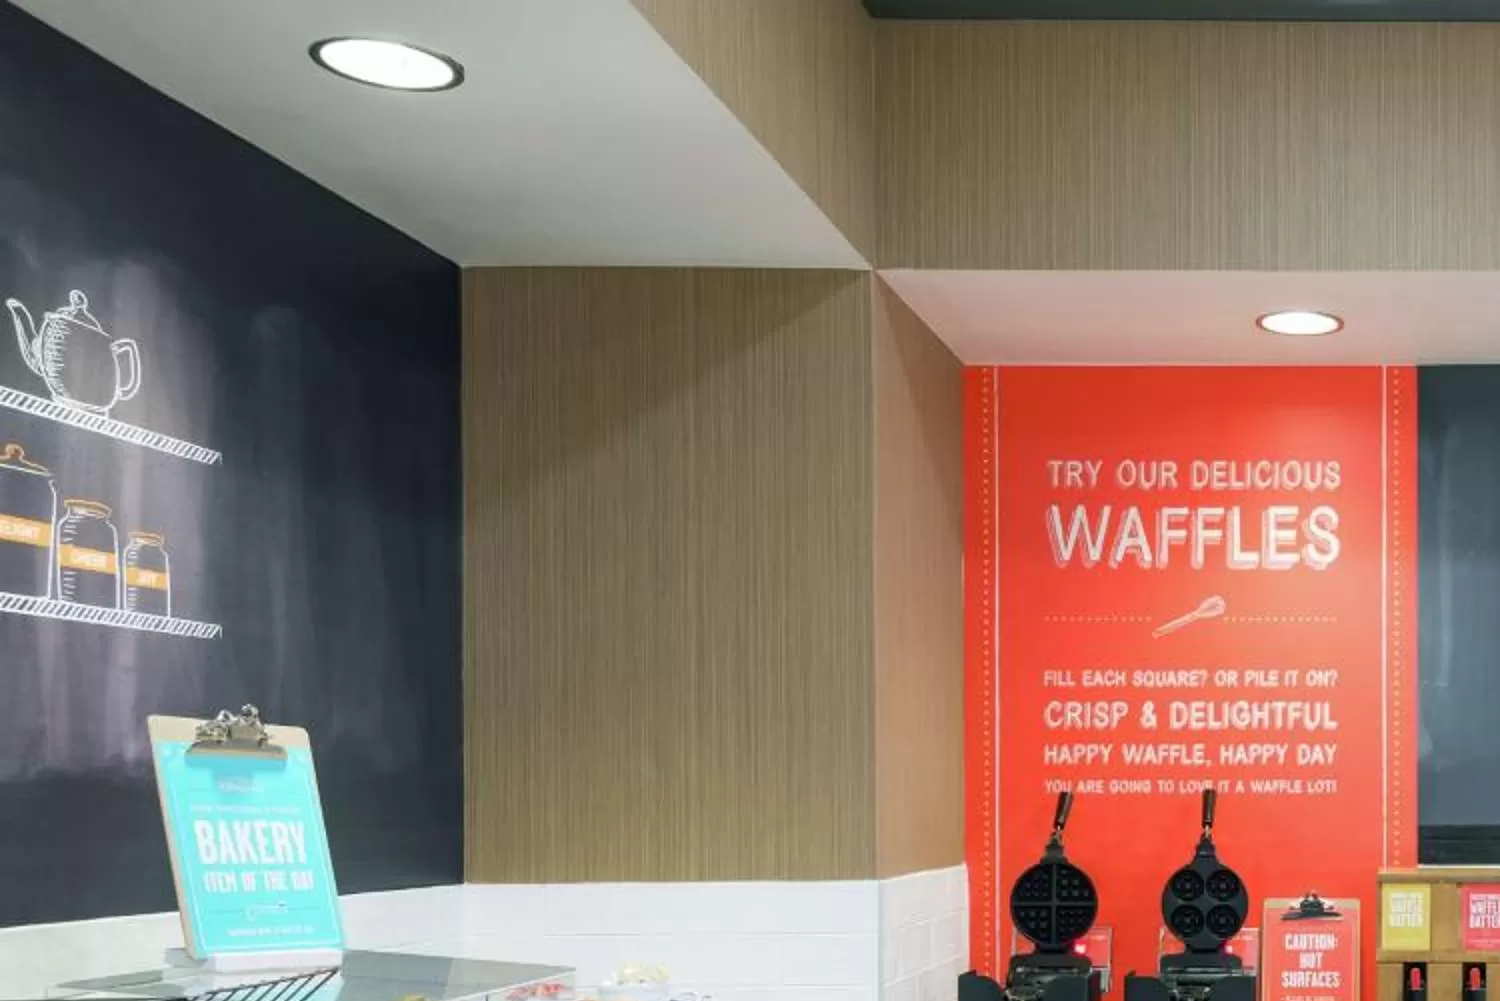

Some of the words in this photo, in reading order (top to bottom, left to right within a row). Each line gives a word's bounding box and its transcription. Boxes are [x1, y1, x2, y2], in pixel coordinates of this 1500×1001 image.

[1047, 459, 1103, 489] TRY
[1116, 459, 1178, 490] OUR
[1189, 459, 1342, 491] DELICIOUS
[1045, 503, 1342, 570] WAFFLES
[1043, 669, 1076, 688] FILL
[1081, 669, 1126, 688] EACH
[1132, 669, 1208, 688] SQUARE?
[1214, 669, 1239, 688] OR
[1244, 669, 1280, 688] PILE
[1284, 669, 1300, 688] IT
[1305, 669, 1338, 688] ON?
[1043, 700, 1129, 730] CRISP
[1139, 700, 1158, 730] &
[1168, 700, 1338, 731] DELIGHTFUL
[1043, 744, 1113, 765] HAPPY
[1122, 744, 1213, 768] WAFFLE,
[1219, 744, 1289, 766] HAPPY
[1296, 744, 1338, 765] DAY
[1044, 779, 1072, 795] YOU
[1076, 779, 1105, 794] ARE
[1109, 779, 1152, 794] GOING
[1157, 779, 1175, 794] TO
[1179, 779, 1214, 794] LOVE
[1217, 779, 1230, 794] IT
[1234, 779, 1246, 794] A
[1250, 779, 1304, 794] WAFFLE
[1307, 779, 1338, 794] LOT!
[193, 818, 308, 865] BAKERY
[203, 871, 238, 893] ITEM
[263, 871, 290, 892] THE
[1284, 932, 1338, 951] CAUTION:
[1299, 951, 1324, 969] HOT
[1281, 970, 1341, 989] SURFACES
